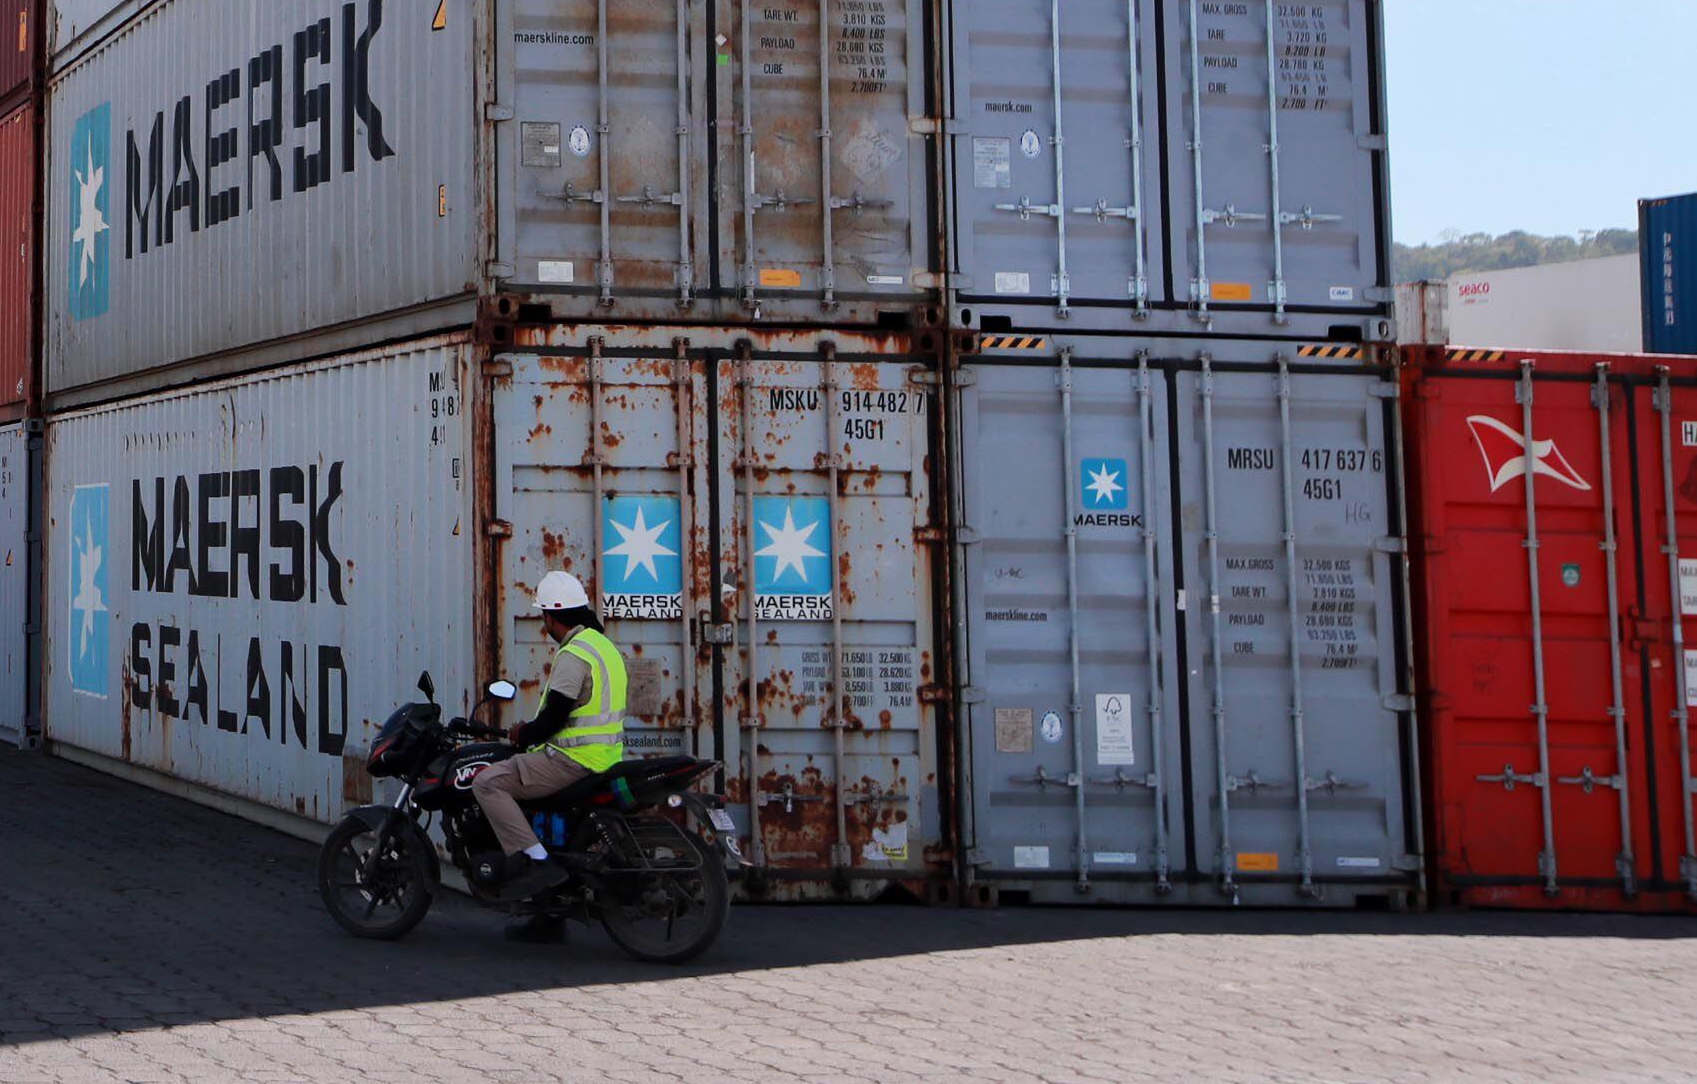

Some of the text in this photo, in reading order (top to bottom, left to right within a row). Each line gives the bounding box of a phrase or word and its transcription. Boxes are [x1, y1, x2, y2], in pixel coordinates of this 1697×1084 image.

[764, 8, 782, 21] TARE
[870, 15, 886, 26] KGS
[1224, 4, 1248, 16] GROSS
[1312, 6, 1323, 18] KG
[514, 32, 594, 45] maerskline.com
[869, 28, 885, 40] LBS
[1207, 28, 1226, 41] TARE
[1316, 32, 1327, 43] KG
[761, 37, 884, 54] PAYLOAD KGS
[764, 63, 784, 75] CUBE
[1204, 56, 1238, 69] PAYLOAD
[1313, 60, 1324, 71] KG
[1208, 81, 1228, 94] CUBE
[985, 101, 1033, 114] maersk.com
[1459, 282, 1490, 296] seaco
[769, 388, 923, 413] MSKU 914 482 7
[844, 419, 884, 441] 45G1
[1684, 422, 1697, 443] H
[1228, 448, 1382, 472] MRSU 417 637 6
[1303, 478, 1342, 500] 45G1
[1074, 514, 1142, 527] MAERSK
[131, 461, 347, 606] MAERSK
[1335, 560, 1351, 572] KGS
[1340, 588, 1356, 600] KGS
[603, 594, 682, 608] MAERSK
[755, 595, 831, 610] MAERSK
[1338, 602, 1355, 613] LBS
[603, 607, 683, 619] SEALAND
[755, 609, 833, 620] SEALAND
[985, 608, 1048, 621] maerskline.com
[1229, 613, 1353, 628] PAYLOAD KGS
[1233, 641, 1255, 654] CUBE
[879, 652, 903, 664] 32.500
[879, 667, 903, 678] 28.620
[131, 622, 348, 756] SEALAND
[845, 681, 865, 693] 8.550
[889, 696, 904, 707] 76.4
[623, 735, 681, 748] sksealand.com
